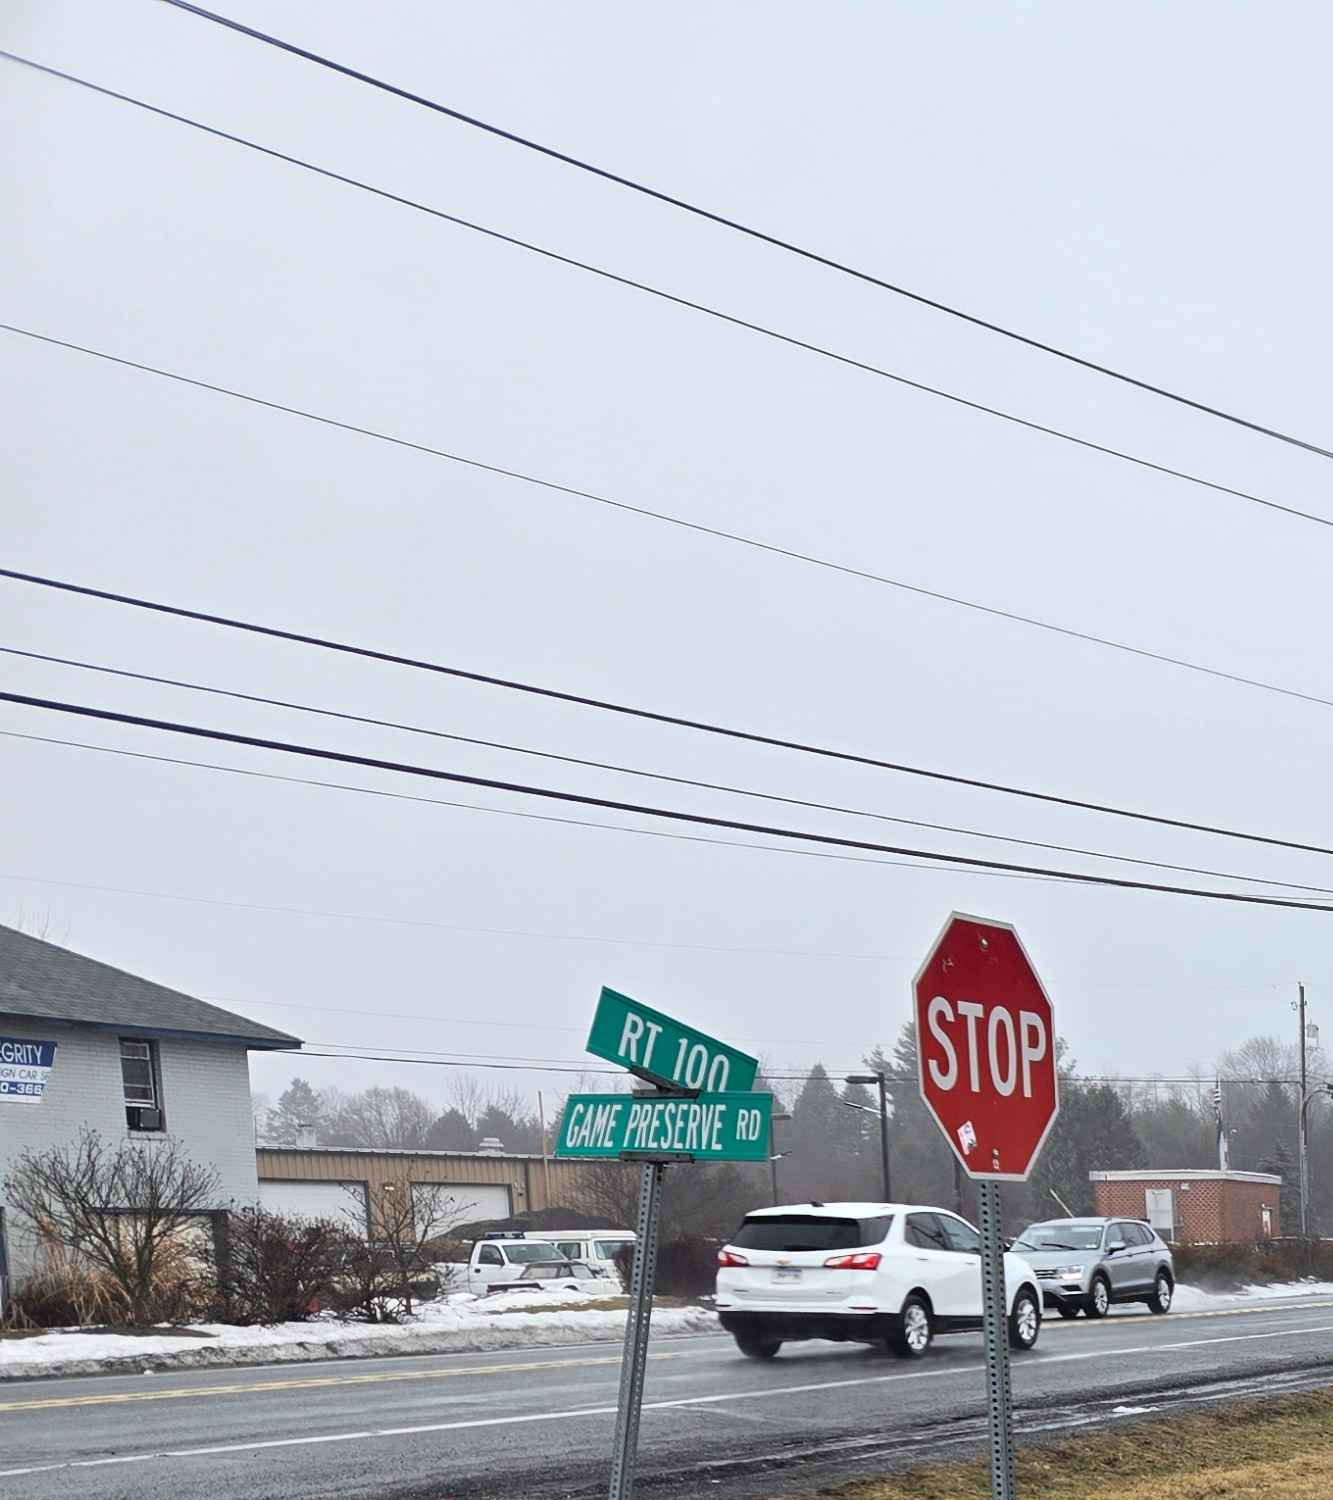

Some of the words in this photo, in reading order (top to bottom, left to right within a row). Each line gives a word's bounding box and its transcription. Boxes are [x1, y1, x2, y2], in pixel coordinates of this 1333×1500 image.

[617, 1011, 663, 1068] RT
[672, 1037, 731, 1092] 100
[927, 996, 1047, 1098] STOP
[565, 1103, 622, 1148] GAME
[622, 1102, 727, 1151] PRESERVE
[735, 1108, 762, 1141] RD
